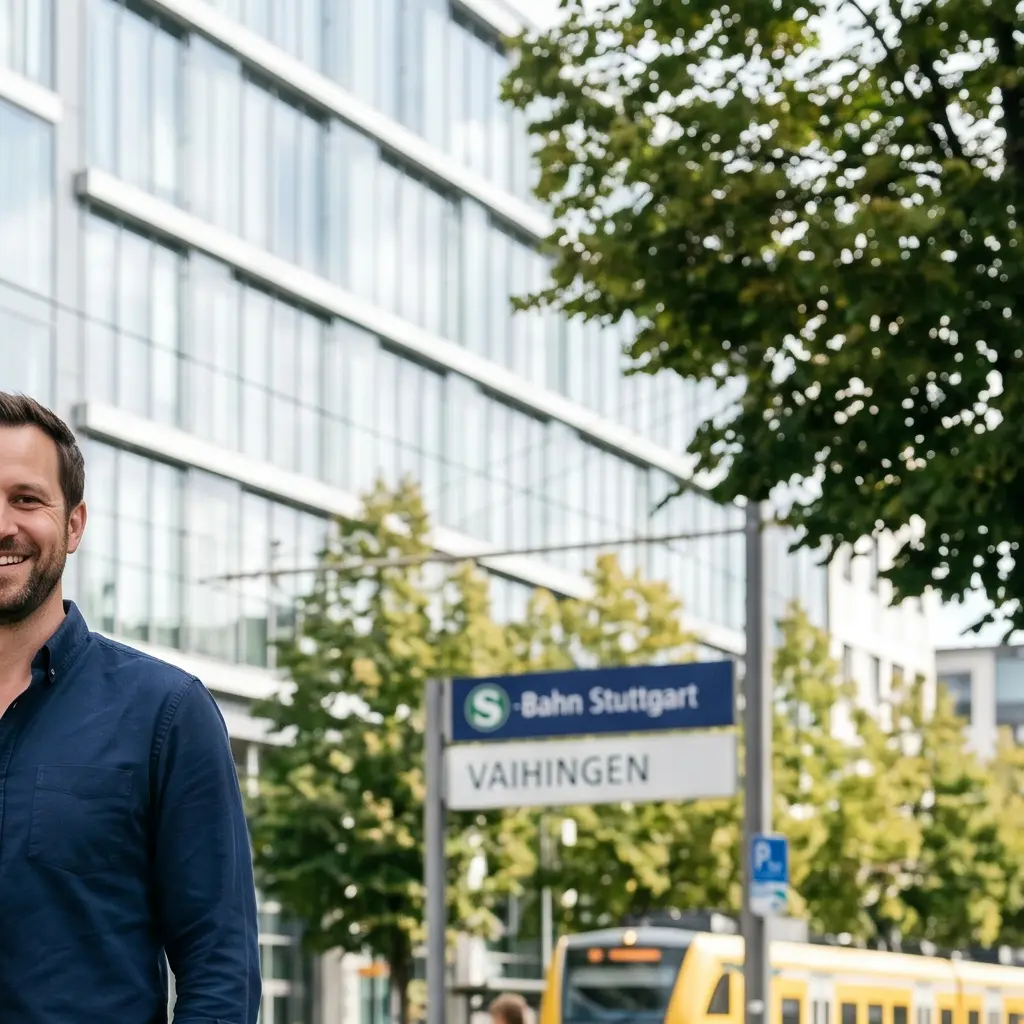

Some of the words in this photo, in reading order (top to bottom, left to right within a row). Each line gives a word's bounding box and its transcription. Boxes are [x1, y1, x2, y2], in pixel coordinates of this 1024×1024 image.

[589, 683, 699, 718] Stuttgart
[467, 754, 651, 790] VAIHINGEN
[755, 841, 771, 869] P
